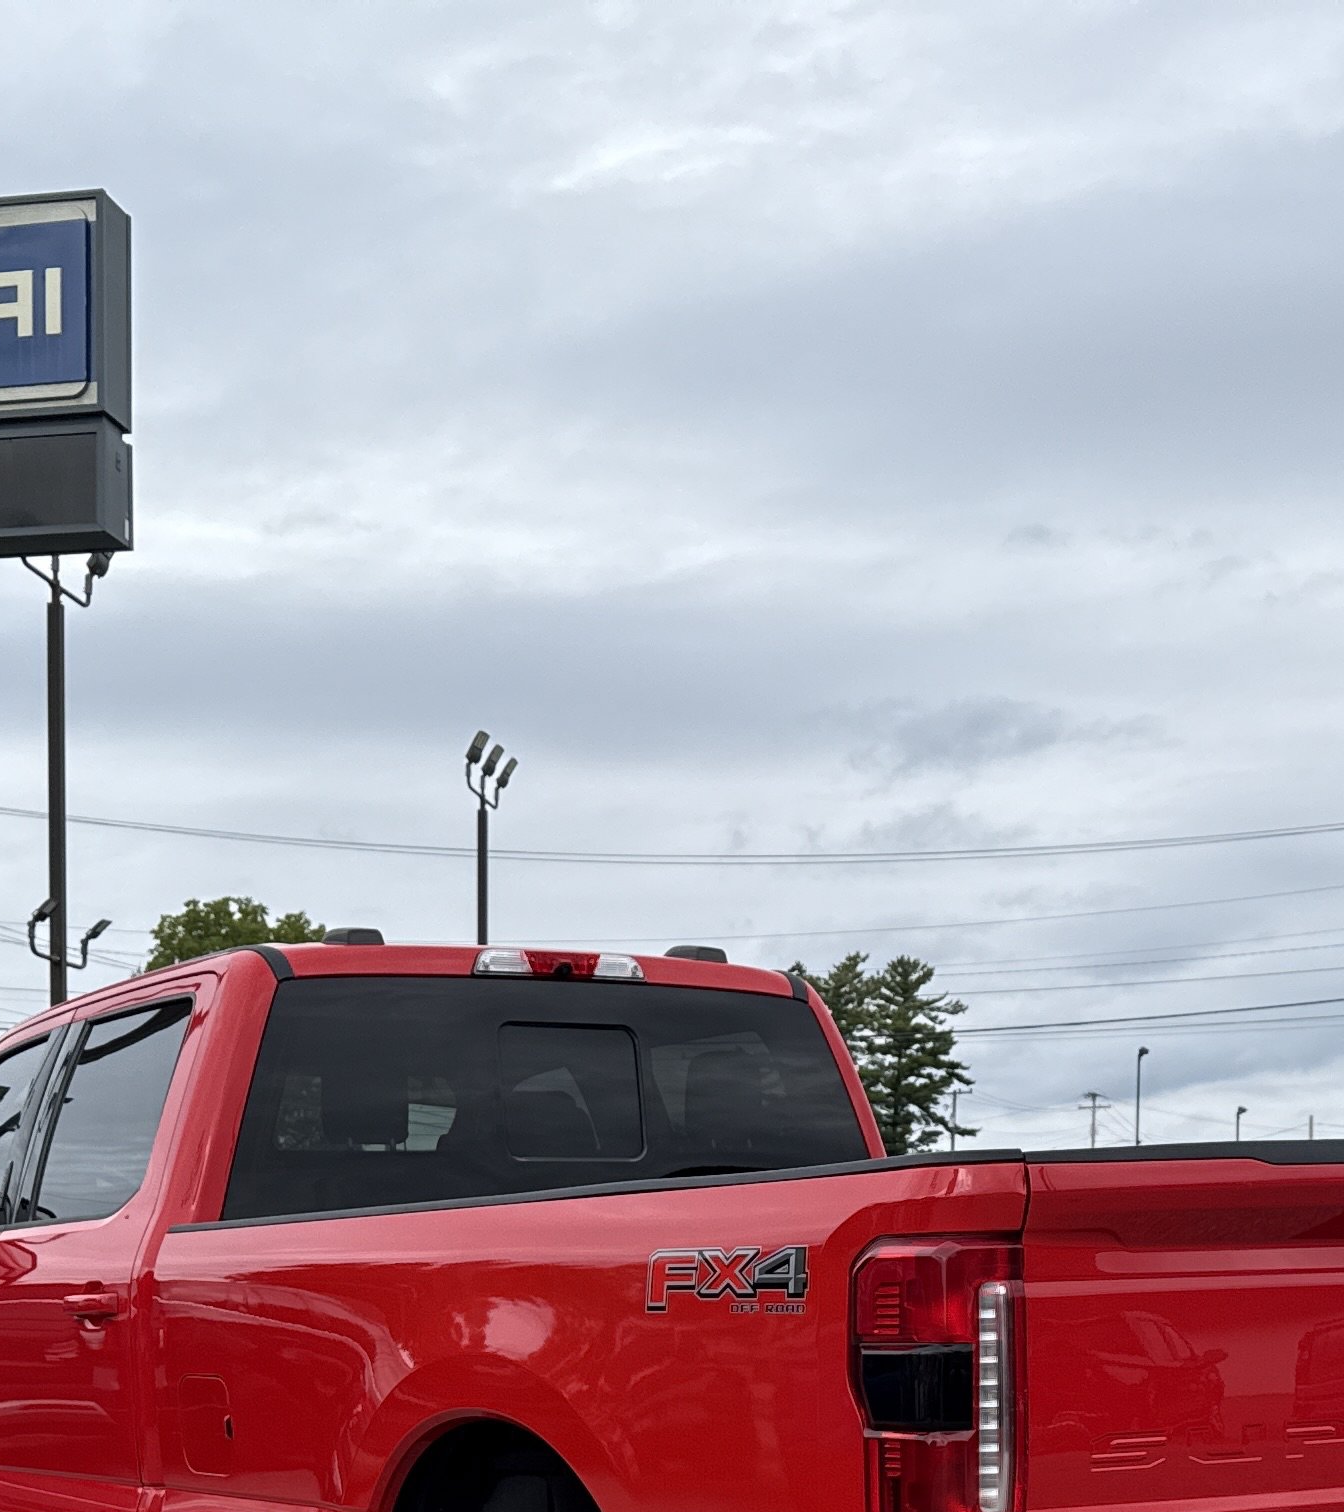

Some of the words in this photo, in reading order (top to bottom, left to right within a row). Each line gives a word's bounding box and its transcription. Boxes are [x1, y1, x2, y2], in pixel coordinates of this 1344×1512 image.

[645, 1246, 810, 1314] FX4
[730, 1302, 760, 1314] OFF
[764, 1302, 807, 1314] ROAD
